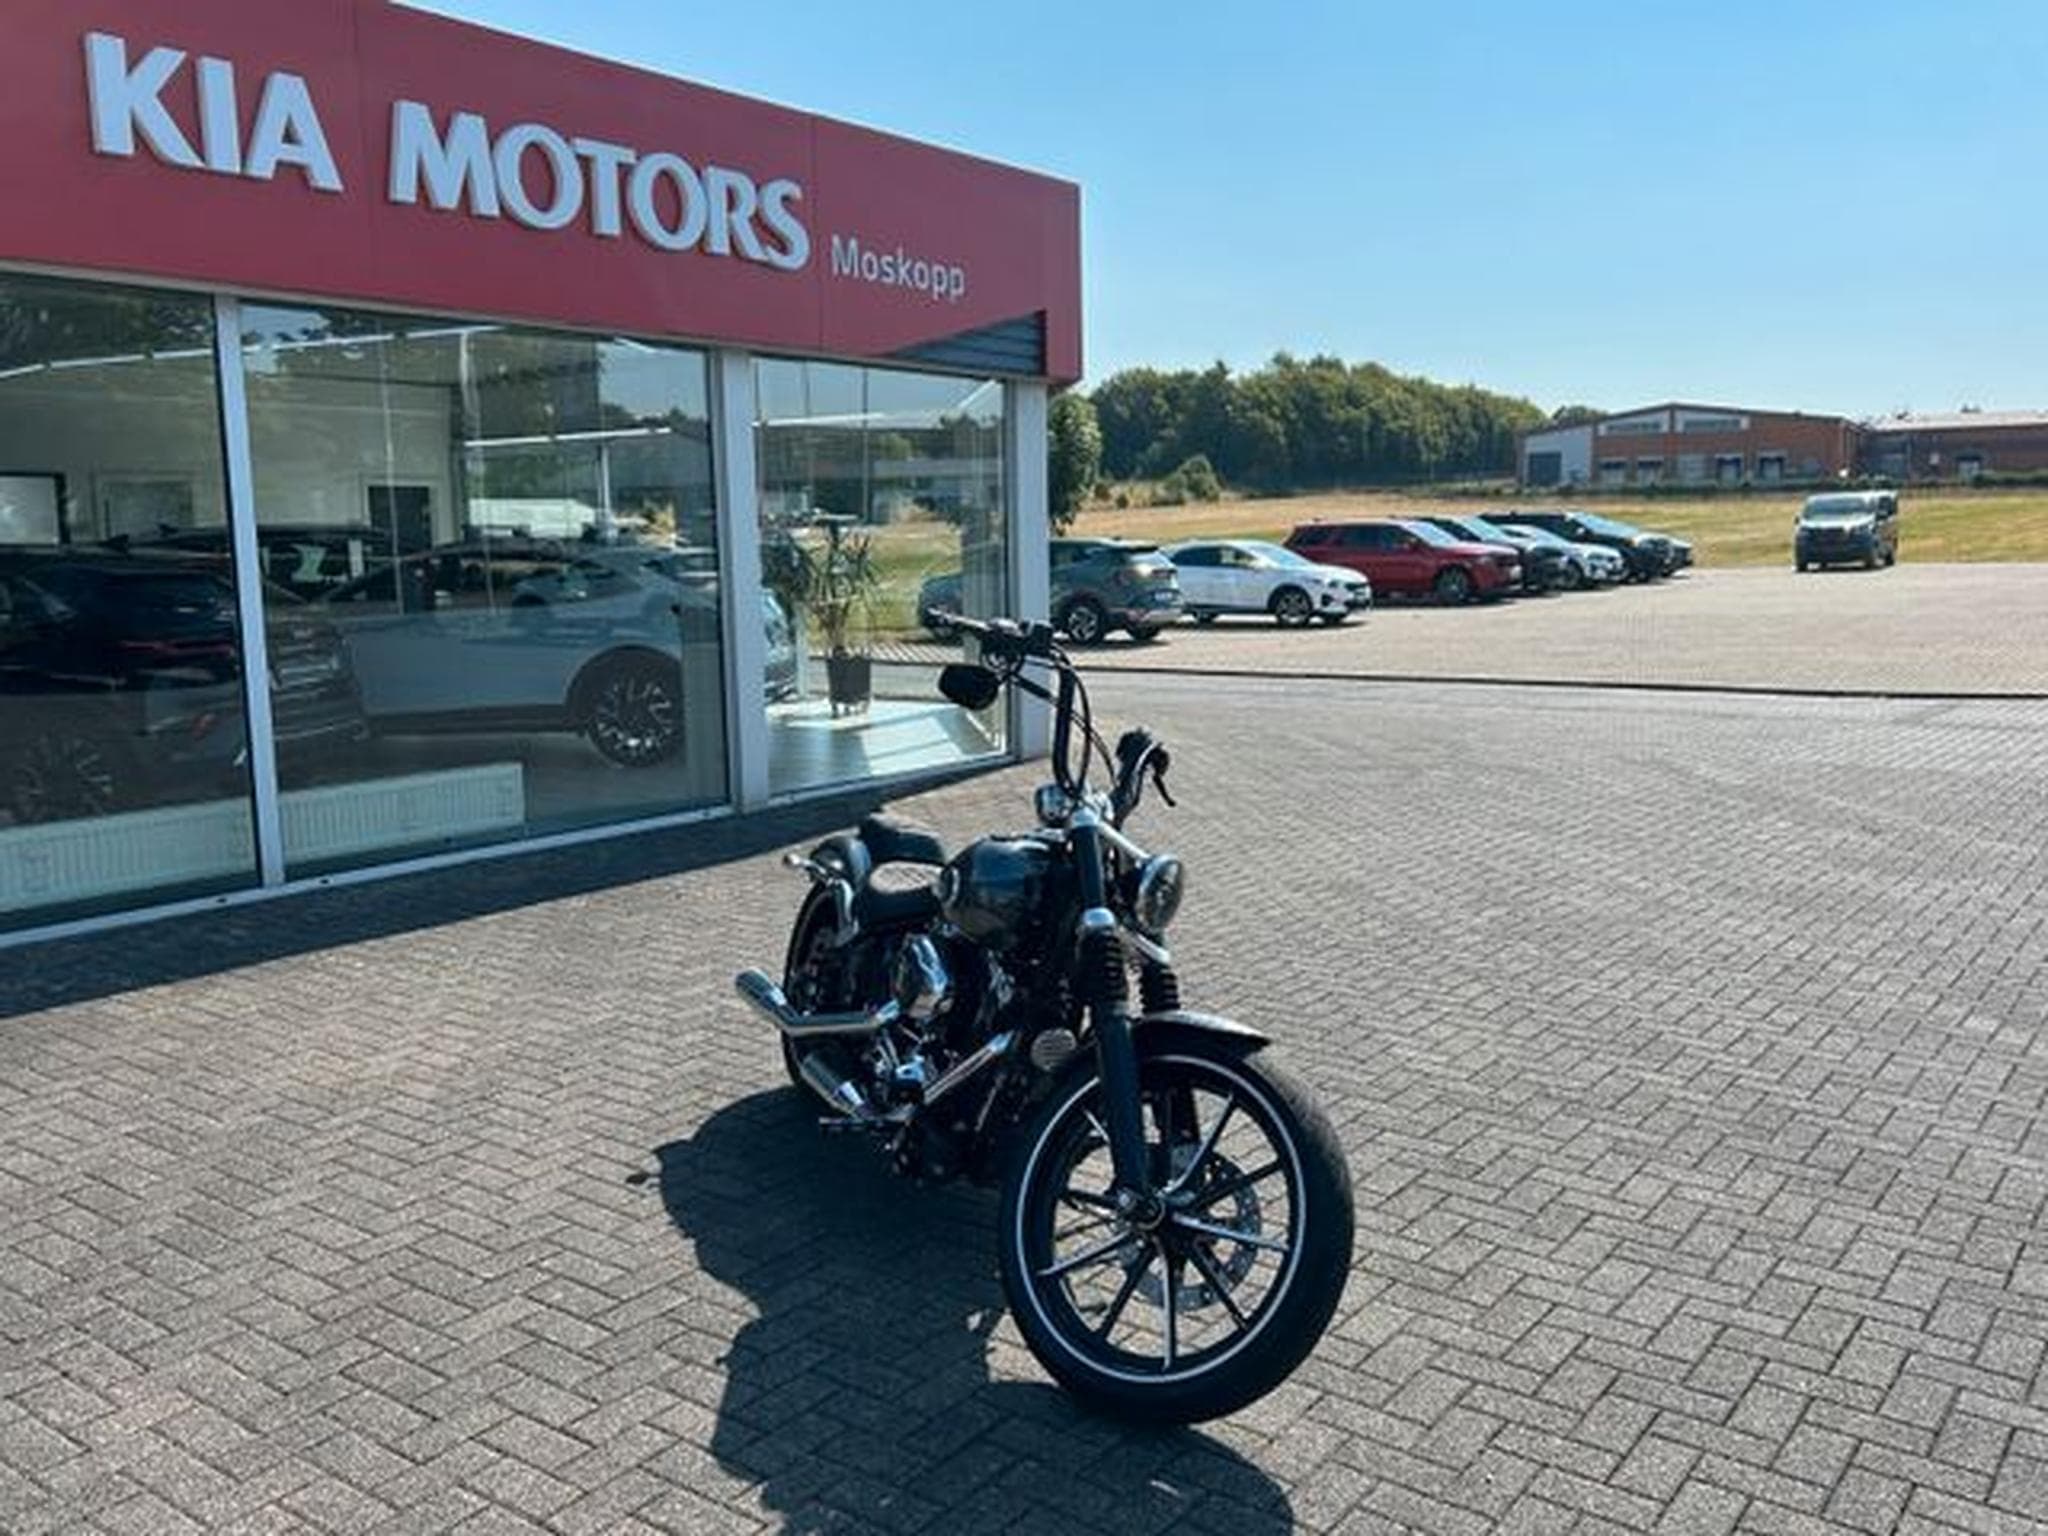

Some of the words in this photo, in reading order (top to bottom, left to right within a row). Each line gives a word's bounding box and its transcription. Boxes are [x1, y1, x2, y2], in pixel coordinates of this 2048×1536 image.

[85, 31, 344, 192] KIA
[389, 100, 811, 270] MOTORS
[831, 234, 966, 302] Moskopp
